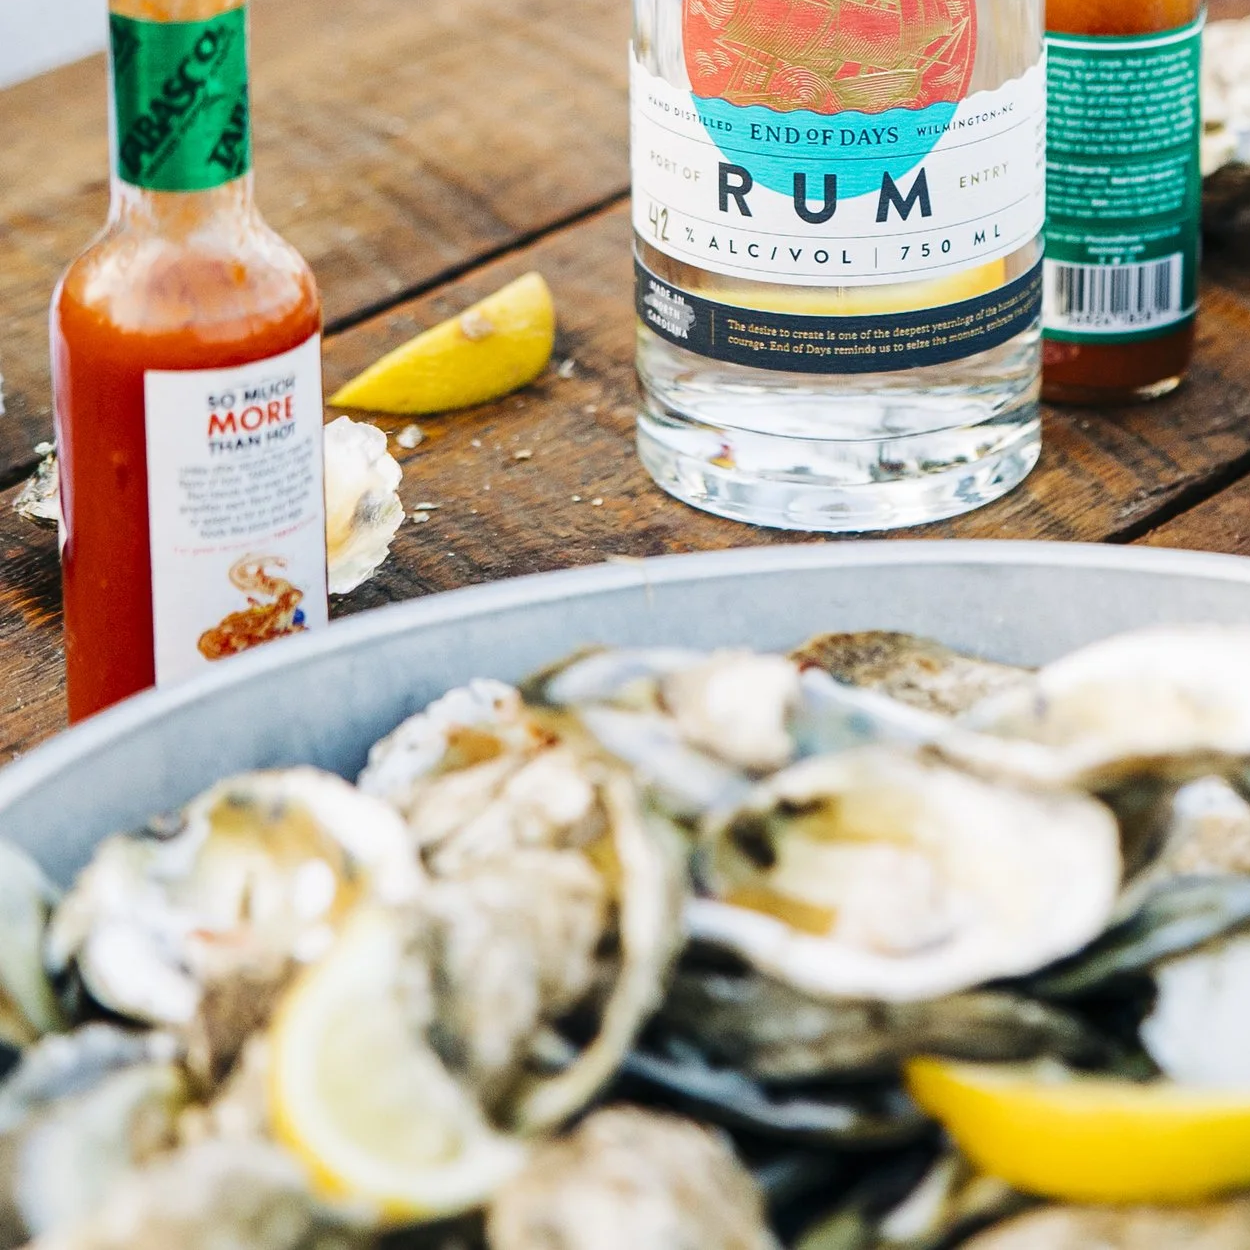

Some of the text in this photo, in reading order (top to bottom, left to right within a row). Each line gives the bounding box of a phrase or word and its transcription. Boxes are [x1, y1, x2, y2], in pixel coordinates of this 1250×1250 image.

[648, 93, 733, 133] HAND DISTILLED
[750, 122, 899, 147] END OF DAYS
[650, 150, 701, 183] PORT OF
[959, 162, 1009, 189] ENTRY
[718, 161, 933, 225] RUM
[648, 202, 1001, 265] 42 % ALC/VOL 750 ML
[650, 280, 685, 306] MADE IN
[647, 310, 688, 339] CAROLINA
[653, 300, 681, 320] NORTH
[727, 318, 746, 332] The
[747, 323, 778, 338] desire
[779, 329, 790, 338] to
[792, 330, 825, 340] create
[827, 330, 837, 340] is
[838, 332, 858, 341] one
[860, 329, 873, 340] of
[873, 327, 891, 338] the
[893, 323, 931, 338] deepest
[931, 316, 974, 334] yearnings
[728, 335, 767, 350] courage.
[770, 341, 790, 353] End
[792, 343, 804, 354] of
[806, 345, 832, 357] Days
[834, 345, 877, 356] reminds
[879, 344, 891, 353] us
[893, 343, 904, 352] to
[906, 339, 930, 351] seize
[932, 335, 948, 347] the
[949, 327, 985, 343] moment,
[207, 376, 296, 409] SO MUCH
[207, 395, 294, 437] MORE
[208, 422, 296, 455] THAN HOT
